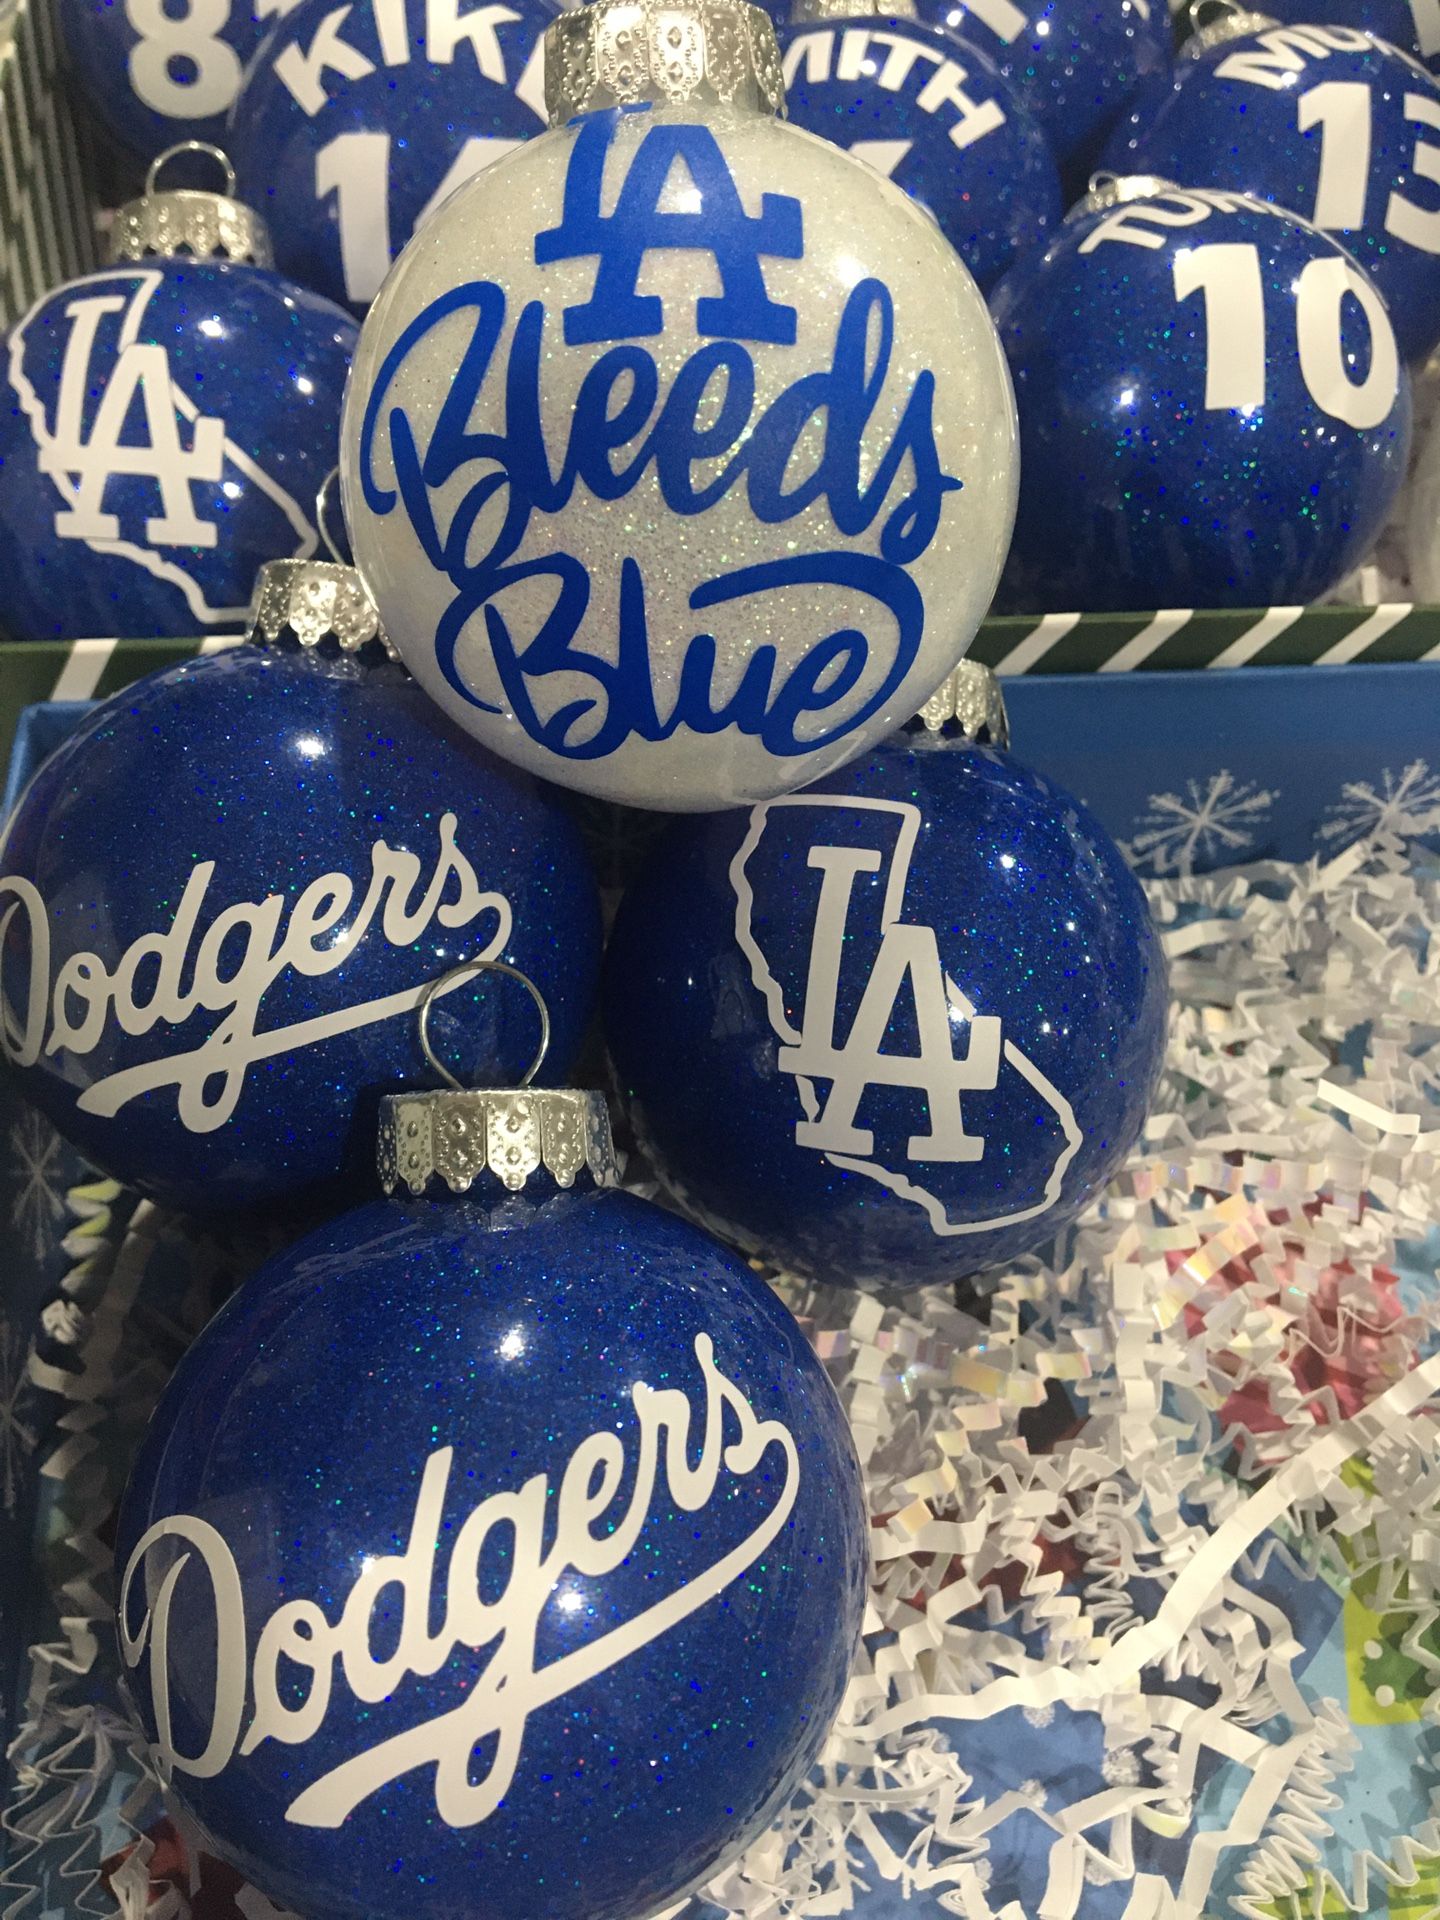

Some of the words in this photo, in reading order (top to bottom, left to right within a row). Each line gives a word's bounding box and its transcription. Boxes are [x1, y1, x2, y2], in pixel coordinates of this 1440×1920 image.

[273, 0, 550, 117] KIK
[315, 133, 525, 302] 1
[534, 102, 804, 346] LA
[1172, 243, 1398, 430] 10
[38, 295, 225, 547] LA
[359, 277, 963, 580] Bleeds
[435, 551, 925, 760] Blue
[0, 812, 512, 1133] Dodgers
[778, 845, 1001, 1162] LA
[118, 1332, 800, 1829] Dodgers
